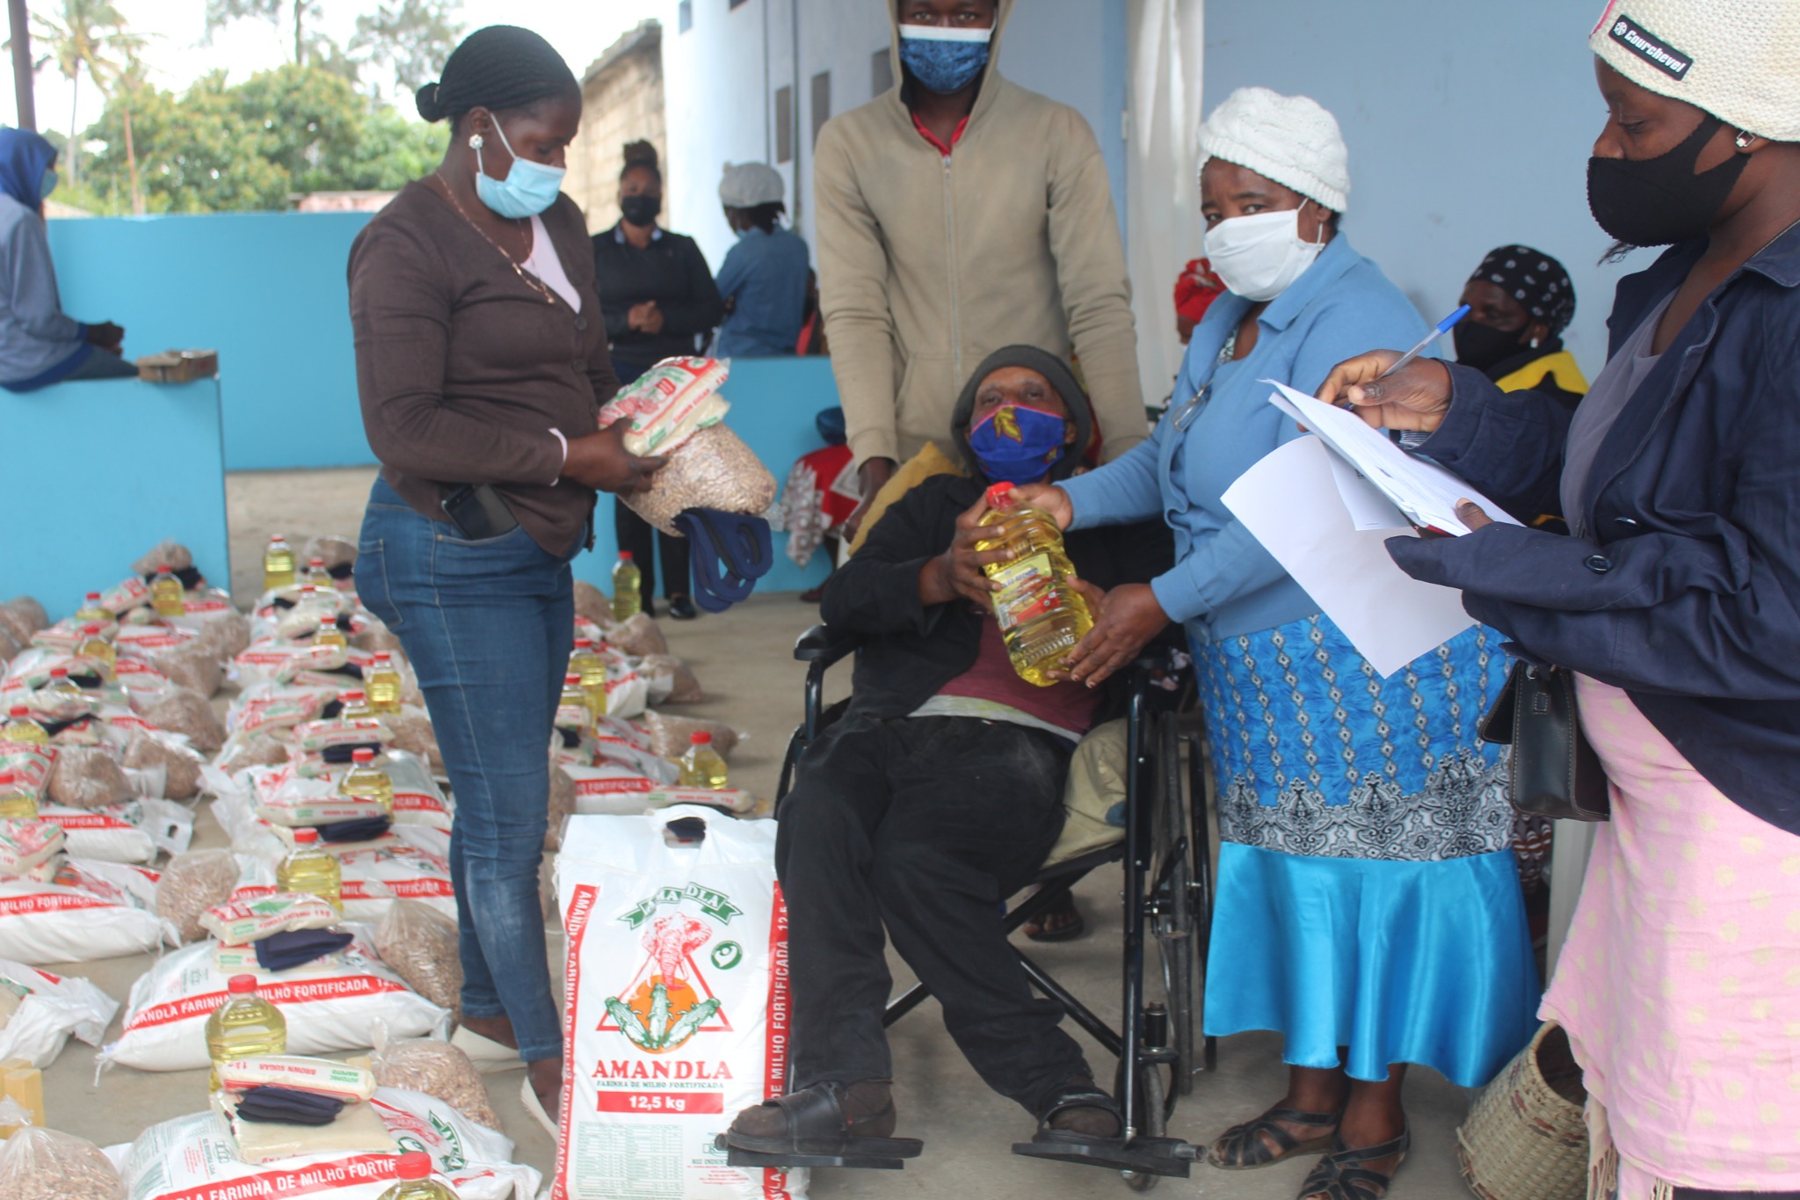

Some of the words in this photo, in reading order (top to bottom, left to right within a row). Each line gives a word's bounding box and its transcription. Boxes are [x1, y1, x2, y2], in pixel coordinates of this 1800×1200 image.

[1624, 29, 1685, 73] Courchevel
[255, 986, 291, 1001] MILHO
[294, 978, 370, 998] FORTIFICADA
[772, 941, 789, 1030] FORTIFICADA
[180, 994, 231, 1014] FARINHA
[592, 1060, 733, 1079] AMANDLA
[771, 1035, 785, 1079] MILHO
[629, 1095, 661, 1111] 12,5
[666, 1095, 685, 1111] kg
[209, 1178, 273, 1200] FARINHA
[277, 1174, 296, 1192] DE
[301, 1167, 345, 1186] MILHO
[349, 1158, 397, 1178] FORTIF
